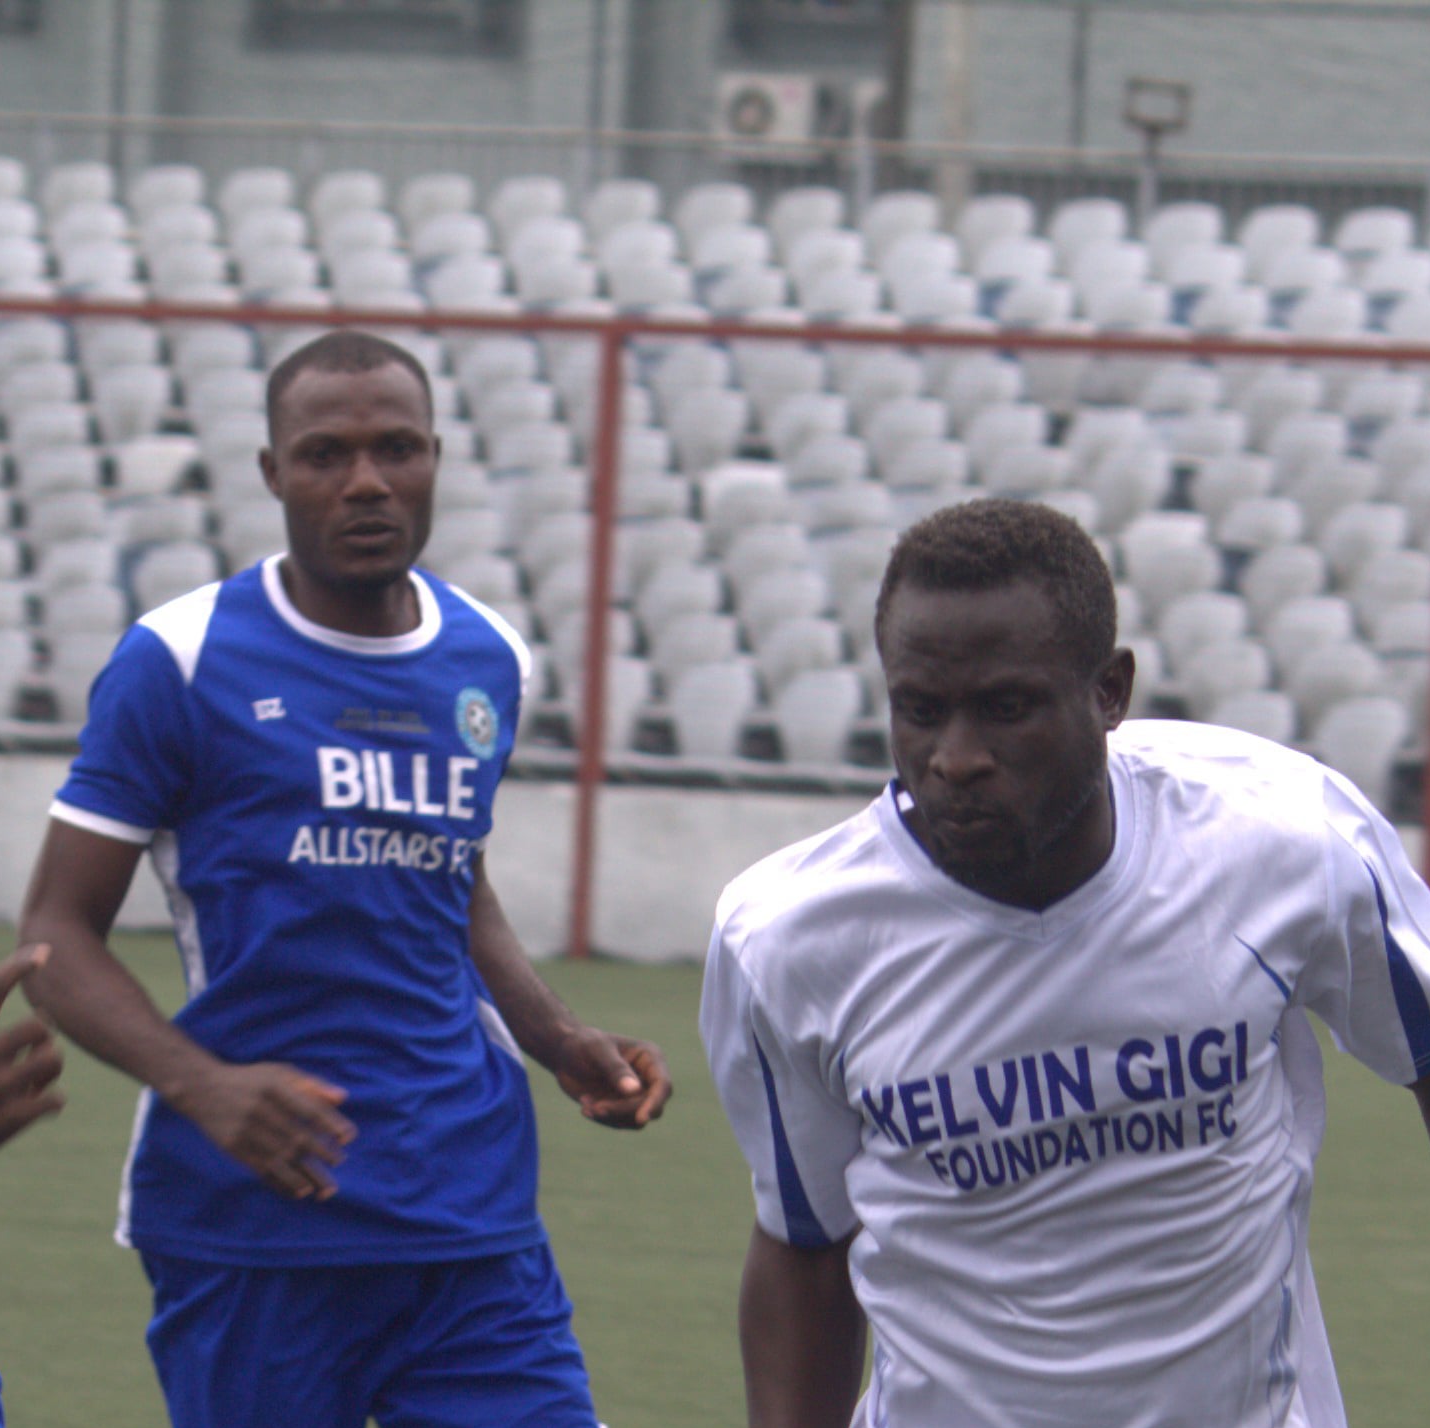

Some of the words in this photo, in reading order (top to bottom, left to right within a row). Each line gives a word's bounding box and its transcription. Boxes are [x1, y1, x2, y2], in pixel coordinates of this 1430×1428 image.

[317, 746, 478, 819] BILLE
[287, 824, 448, 872] ALLSTARS
[862, 1046, 1096, 1148] KELVIN
[1115, 1021, 1248, 1103] GIGI
[926, 1109, 1184, 1191] FOUNDATION
[1197, 1093, 1237, 1146] FC
